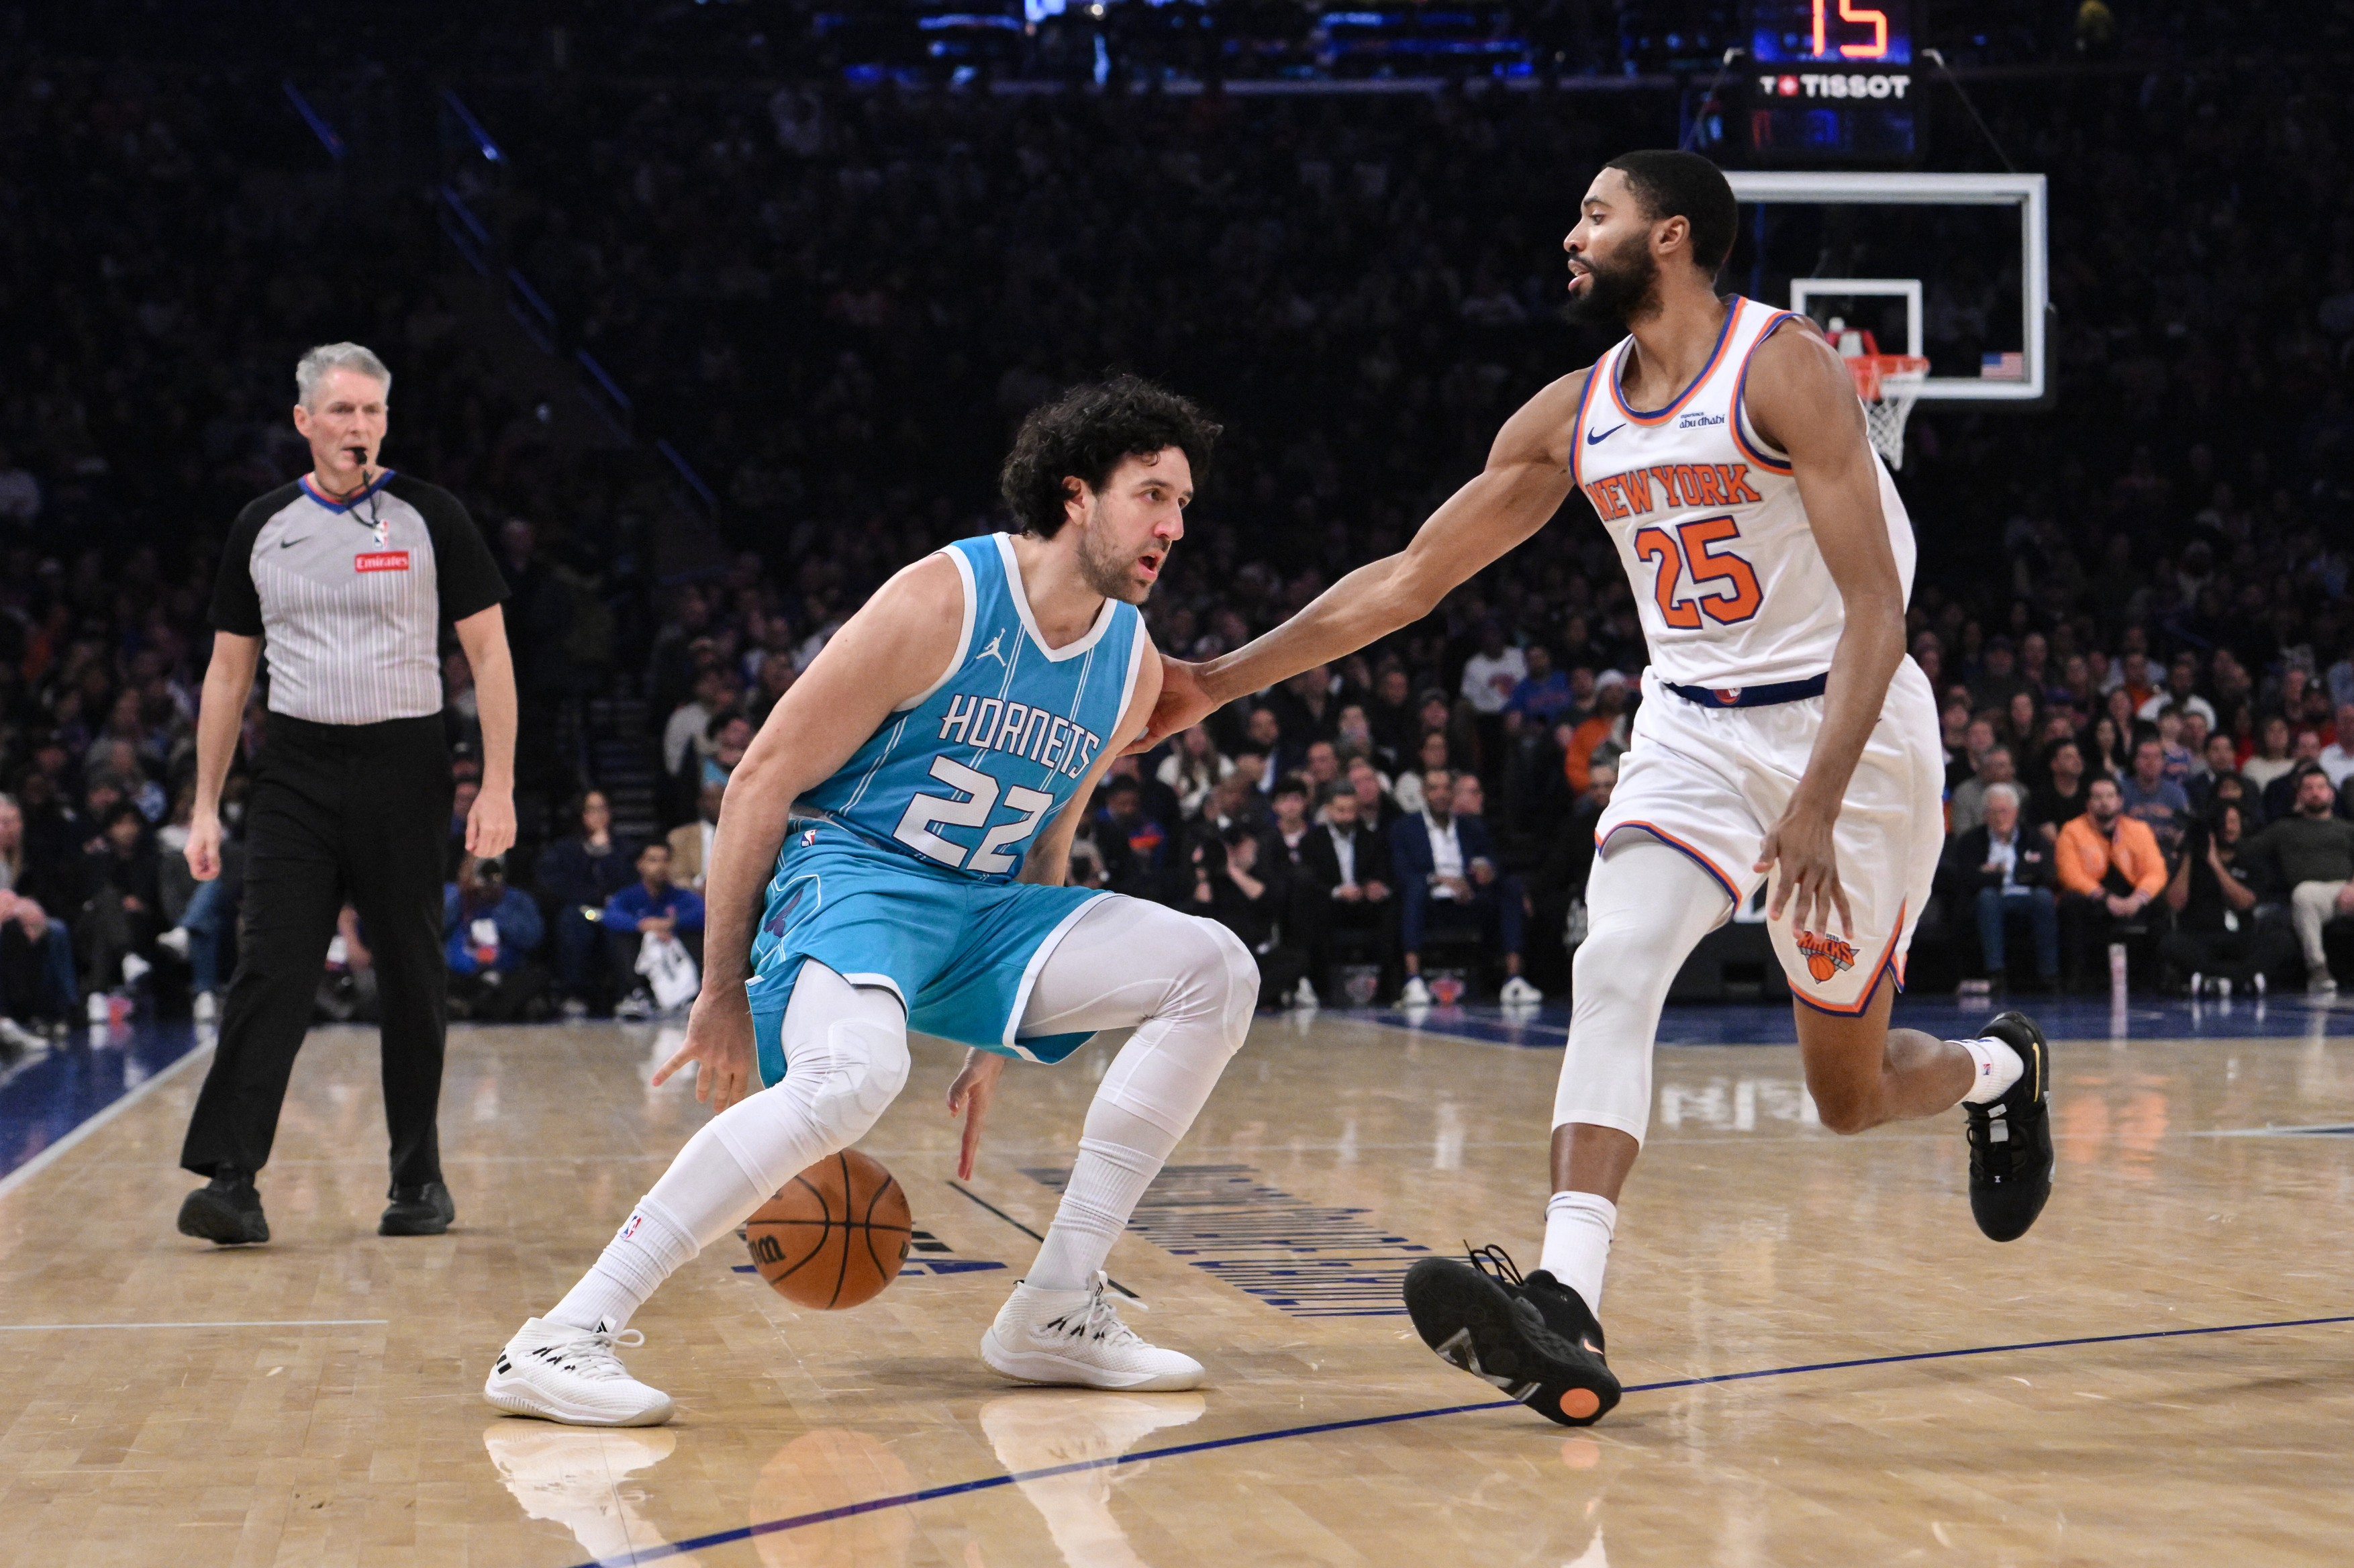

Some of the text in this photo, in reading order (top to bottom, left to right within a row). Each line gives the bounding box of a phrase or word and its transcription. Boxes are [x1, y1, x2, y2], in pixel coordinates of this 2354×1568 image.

[1812, 0, 1887, 58] 15
[1800, 75, 1910, 99] TISSOT
[1679, 413, 1726, 429] abu dhabi
[1585, 463, 1762, 522] NEW YORK
[356, 555, 408, 570] Emirates
[1634, 514, 1764, 630] 25
[938, 693, 1101, 780] HORNETS
[892, 754, 1055, 874] 22
